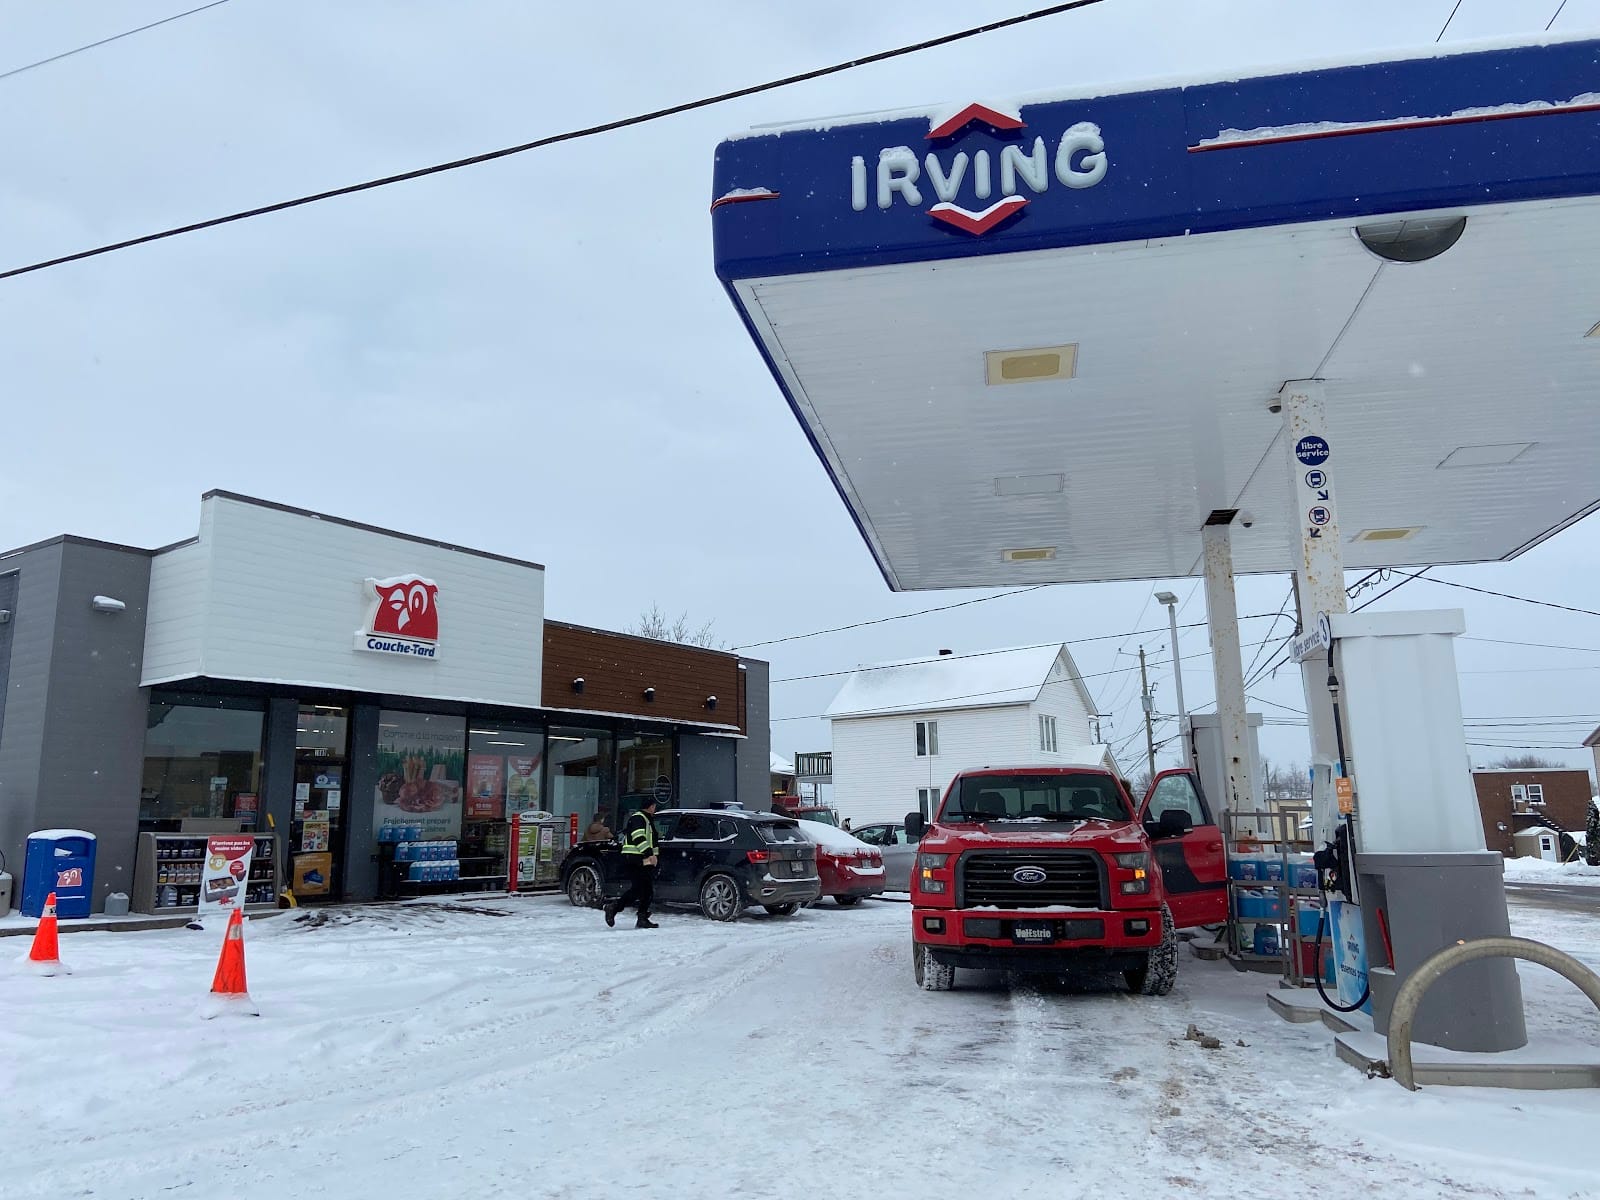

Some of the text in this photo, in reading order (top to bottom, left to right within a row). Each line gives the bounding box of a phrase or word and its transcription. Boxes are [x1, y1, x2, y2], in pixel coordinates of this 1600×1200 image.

[851, 121, 1108, 211] IRVING
[1301, 442, 1323, 450] libre
[1297, 449, 1329, 458] service
[1320, 619, 1328, 642] 3
[367, 638, 436, 657] Couche-Tard
[1020, 872, 1039, 880] Ford
